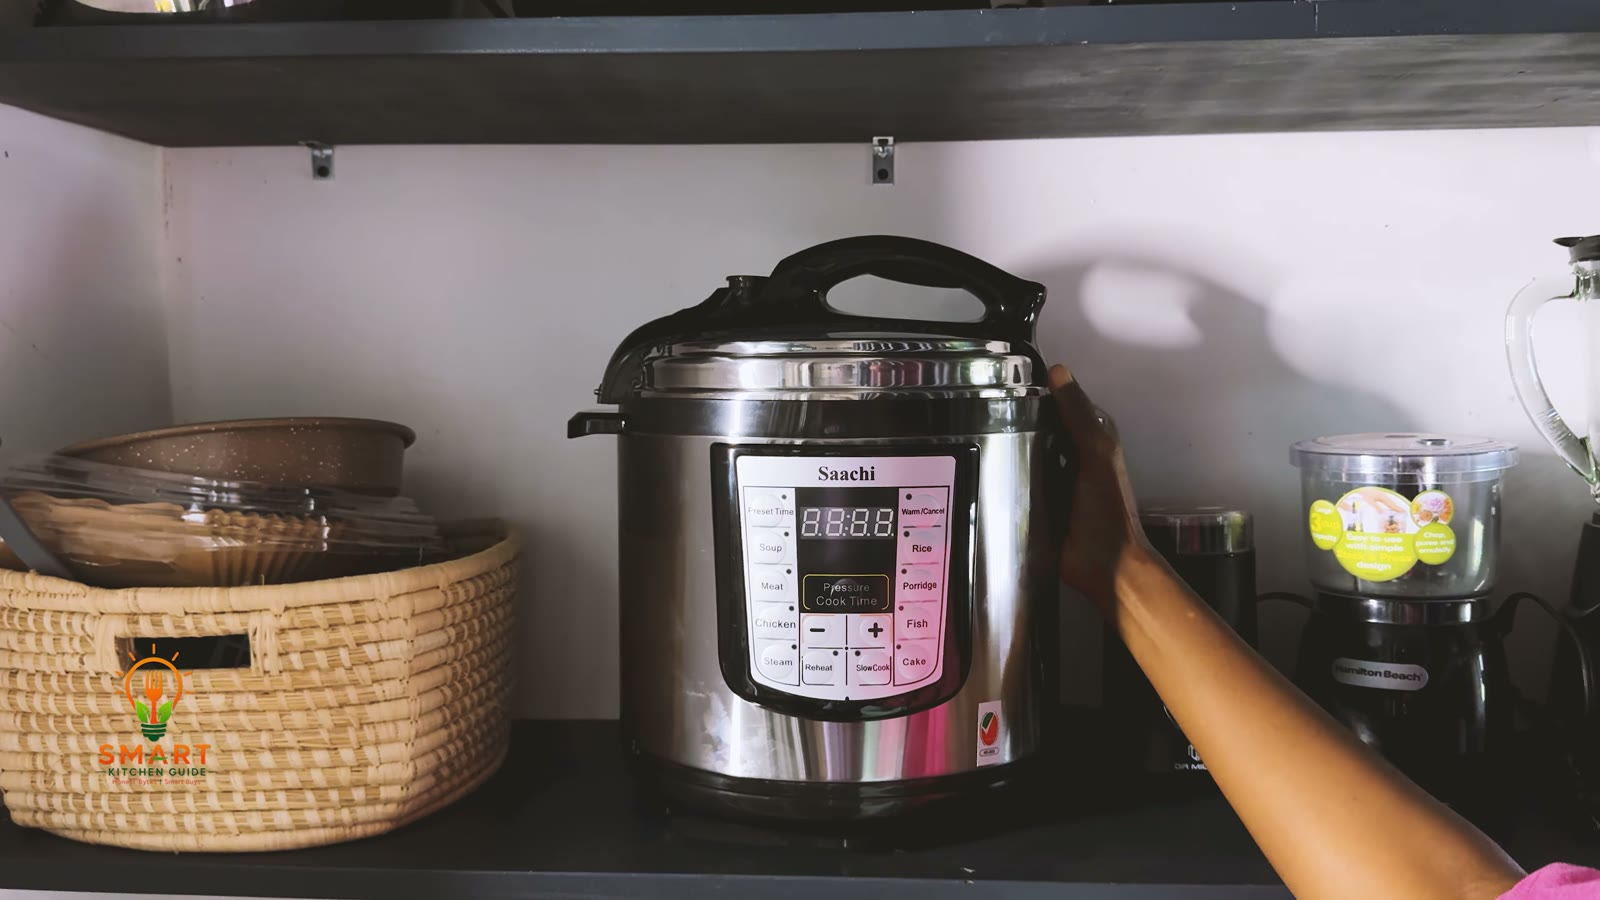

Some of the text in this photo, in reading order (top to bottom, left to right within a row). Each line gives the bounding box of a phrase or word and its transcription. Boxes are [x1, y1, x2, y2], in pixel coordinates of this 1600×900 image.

[818, 466, 876, 481] Saachi
[748, 507, 794, 516] Preset Time
[759, 543, 783, 553] Soup
[912, 544, 932, 553] Rice
[1356, 561, 1391, 571] design
[761, 582, 783, 590] Meat
[823, 582, 870, 592] Pressure
[903, 581, 937, 591] Porridge
[816, 595, 878, 606] Cook Time
[755, 618, 796, 628] Chicken
[906, 619, 928, 628] Fish
[764, 658, 793, 666] Steam
[902, 658, 926, 666] Cake
[805, 664, 833, 672] Reheat
[1336, 664, 1382, 677] Hamilton
